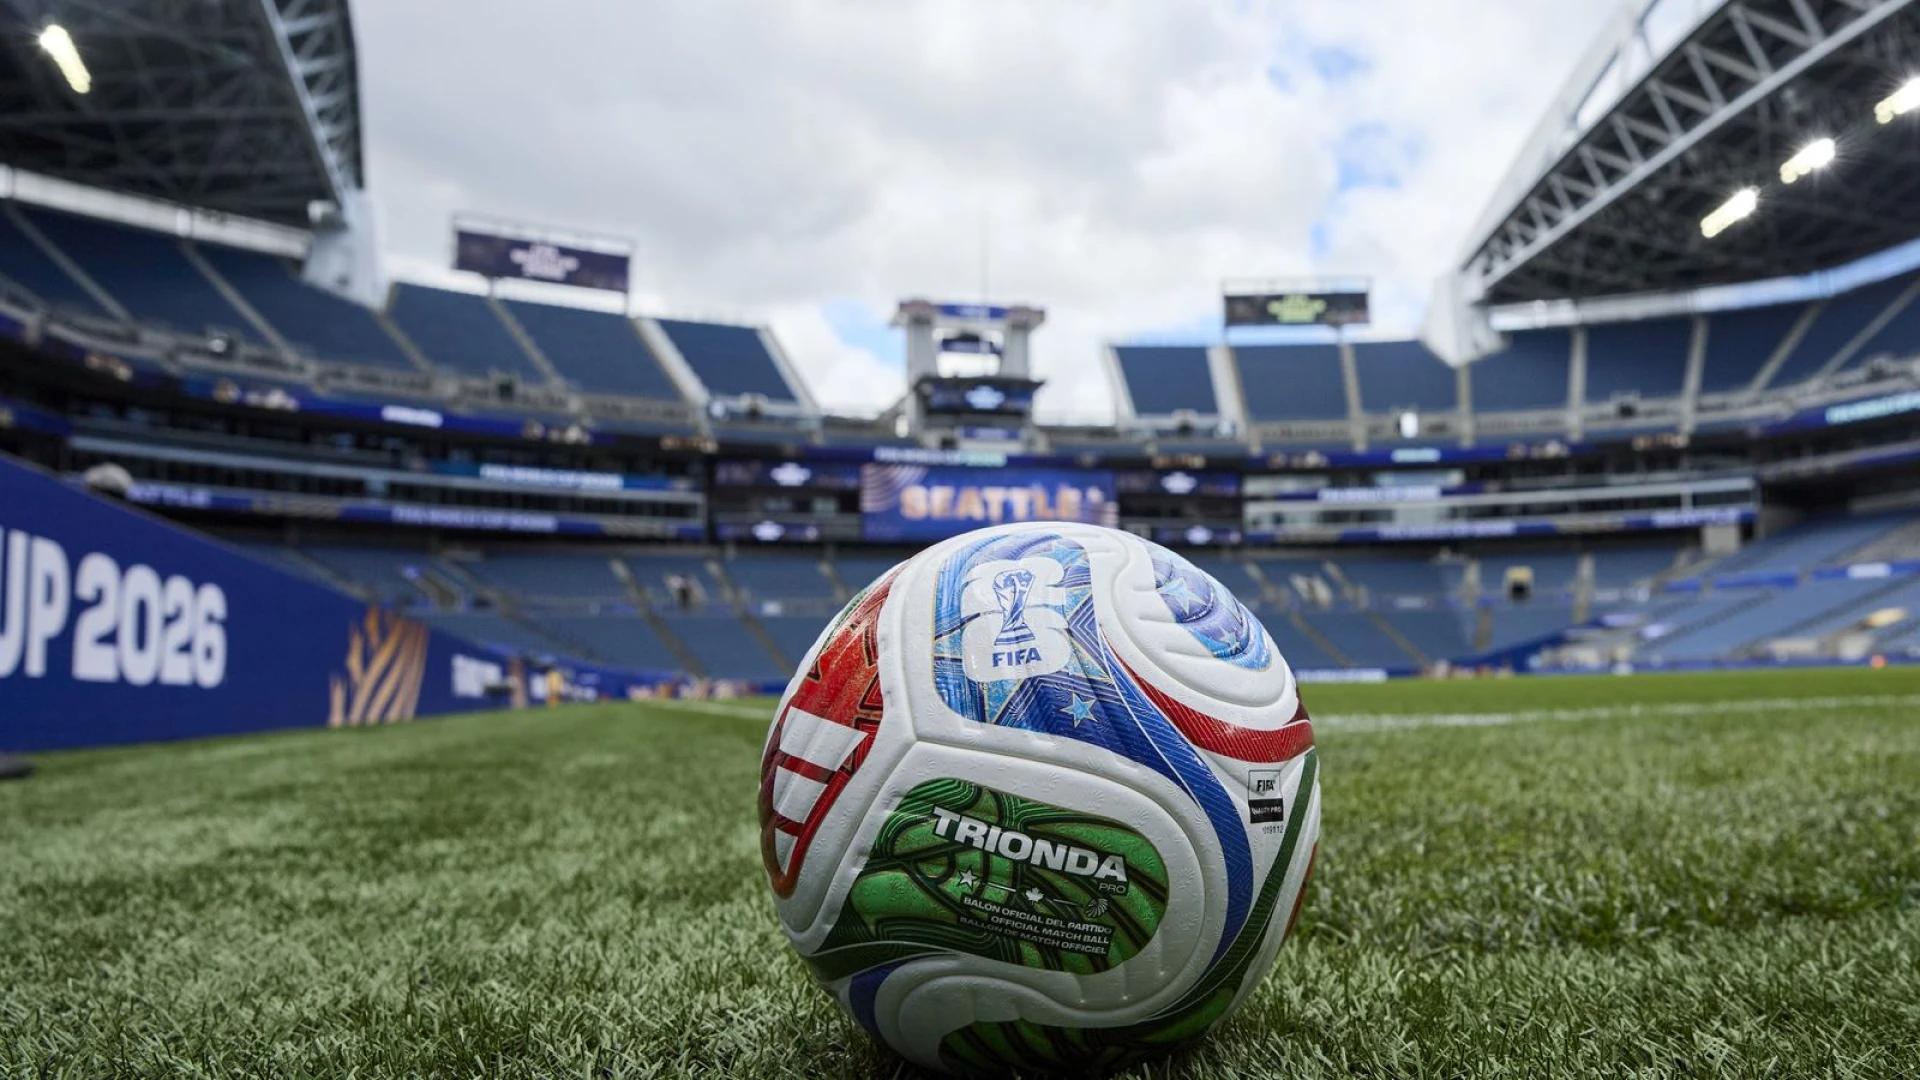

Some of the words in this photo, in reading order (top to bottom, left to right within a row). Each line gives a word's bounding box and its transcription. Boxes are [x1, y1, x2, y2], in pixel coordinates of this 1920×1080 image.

[902, 485, 1083, 520] SEATTLE
[72, 551, 227, 689] 2026
[992, 647, 1042, 667] FIFA
[933, 806, 1128, 882] TRIONDA
[1099, 883, 1126, 894] PRO
[959, 916, 1003, 933] BALLON
[1005, 929, 1019, 938] DE
[1020, 933, 1060, 947] MATCH
[1061, 940, 1107, 955] OFFICIEL
[991, 916, 1040, 933] OFFICIAL
[1042, 928, 1082, 941] MATCH
[1083, 934, 1110, 944] BALL
[1001, 907, 1043, 924] OFICIAL
[1045, 917, 1066, 928] DEL
[1067, 922, 1112, 934] PARTIDO
